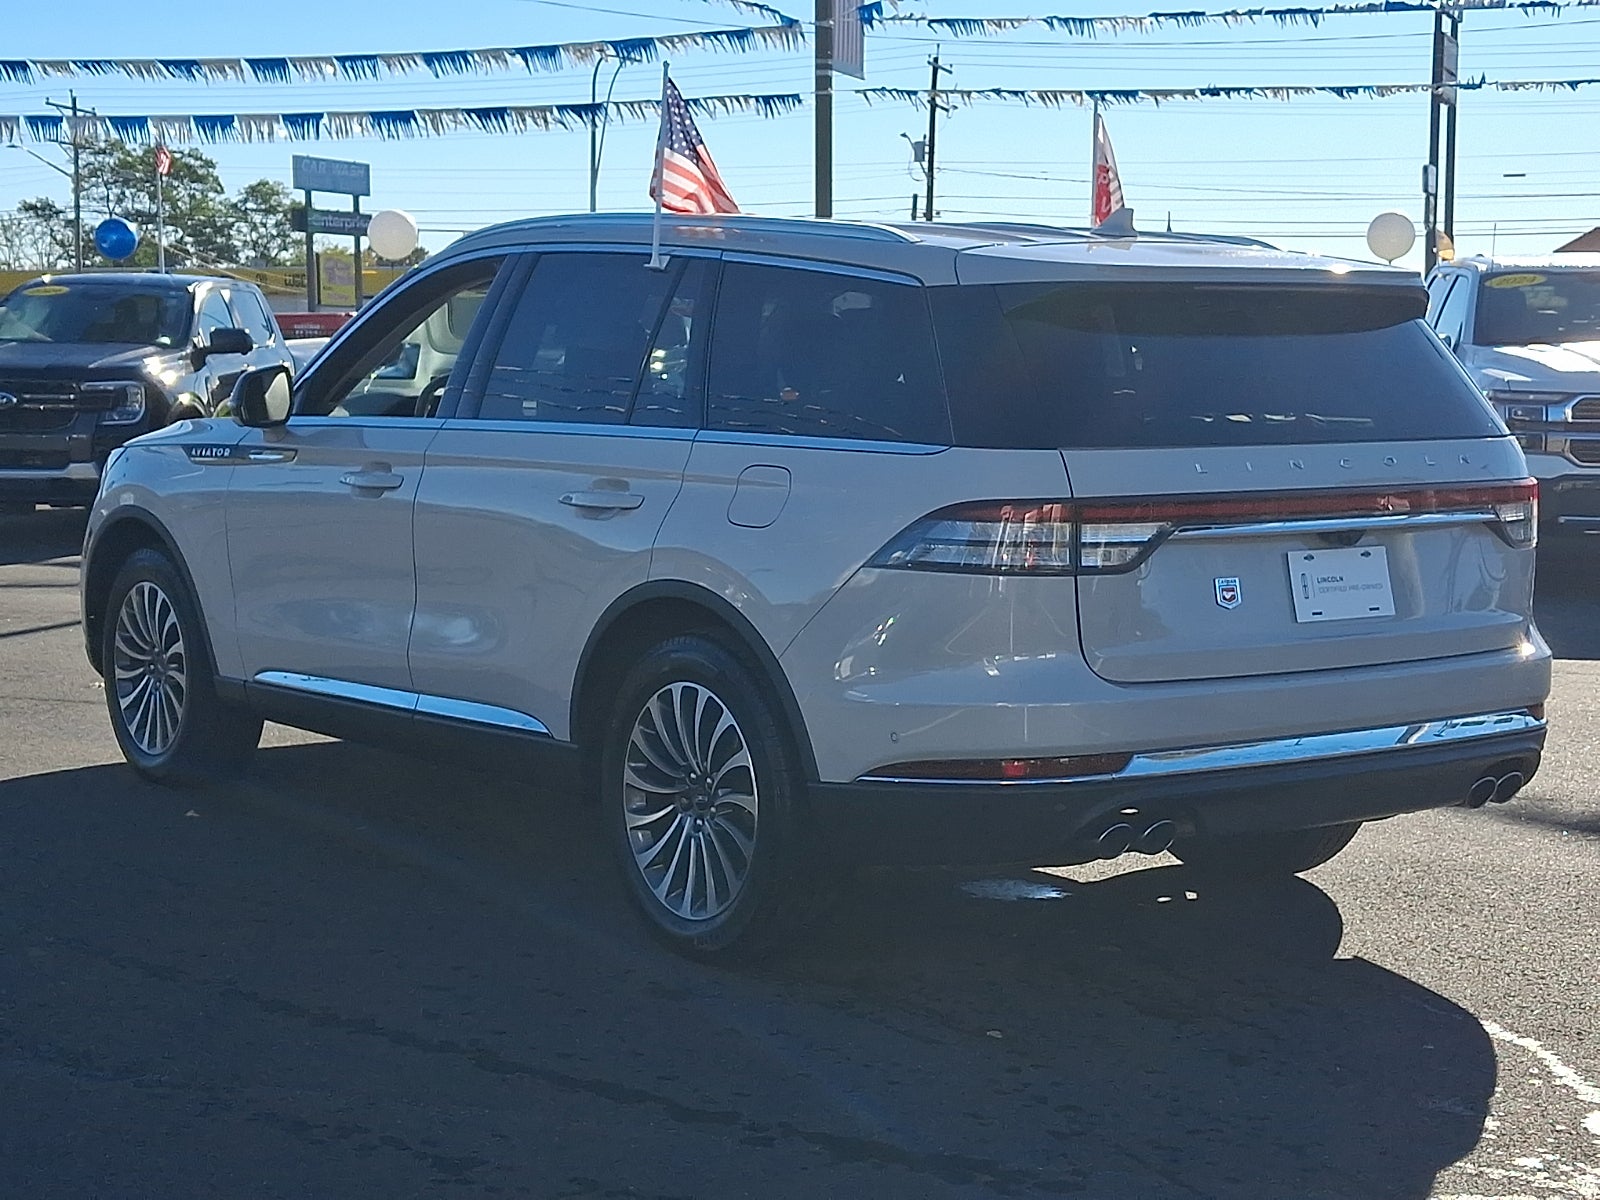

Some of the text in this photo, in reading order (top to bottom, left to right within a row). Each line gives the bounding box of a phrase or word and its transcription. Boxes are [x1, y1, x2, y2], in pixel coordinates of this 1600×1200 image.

[301, 159, 366, 177] CAR WASH
[311, 213, 369, 229] enterpris
[191, 447, 231, 457] AVIATOR
[1195, 453, 1471, 475] LINCOLN
[1316, 575, 1344, 584] LINCOLN
